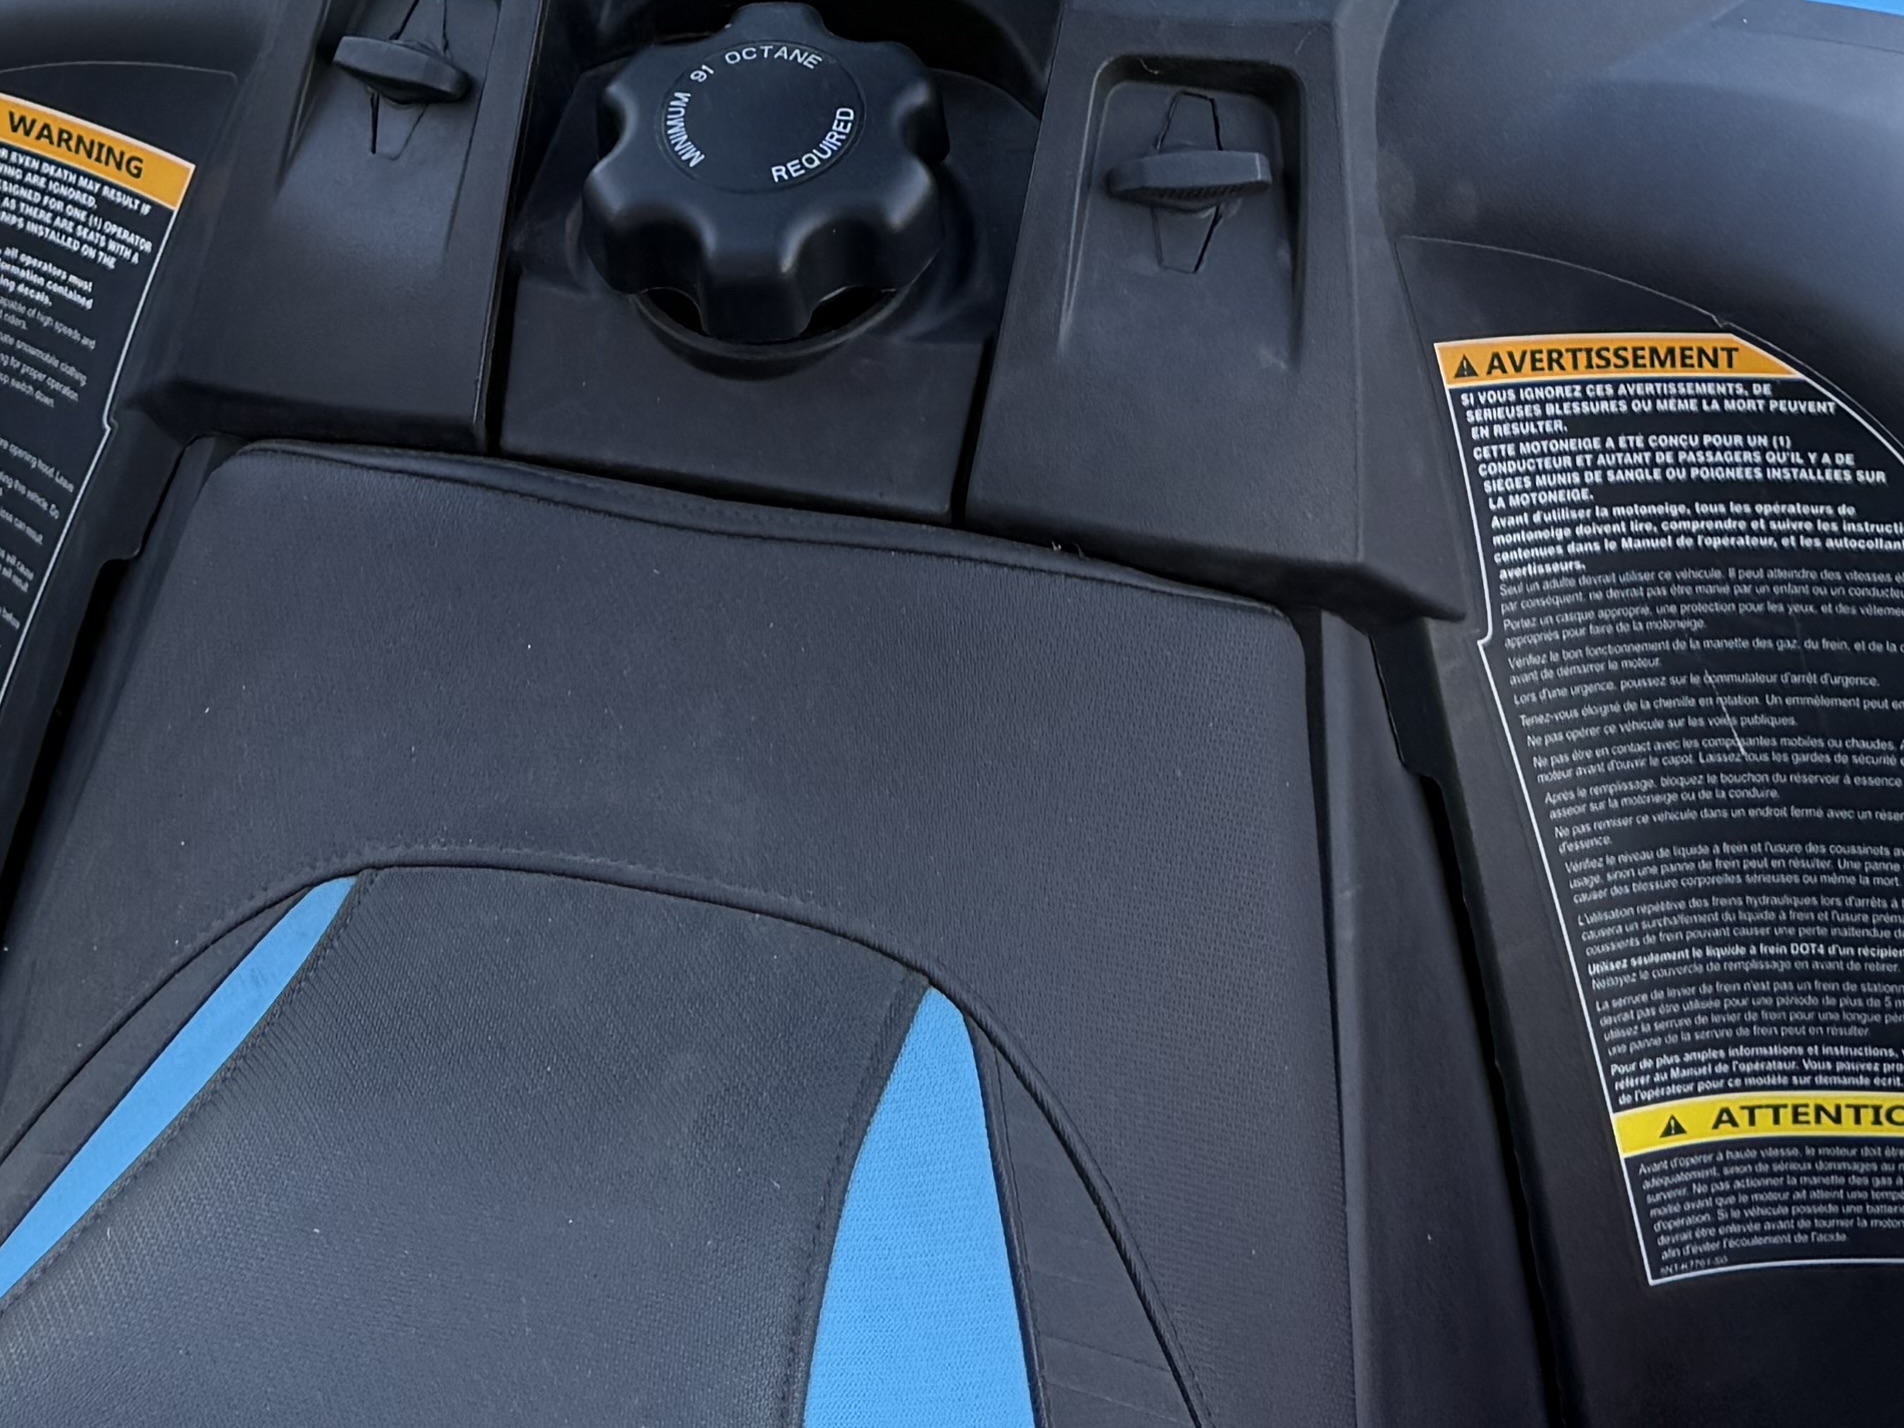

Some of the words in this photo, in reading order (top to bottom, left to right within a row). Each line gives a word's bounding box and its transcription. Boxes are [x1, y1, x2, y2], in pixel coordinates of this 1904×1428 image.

[725, 45, 823, 70] OCTANE
[689, 64, 715, 84] 91
[664, 90, 705, 169] MINIMUM
[8, 110, 144, 179] WARNING
[771, 107, 854, 183] REQUIRED
[10, 151, 40, 169] EVEN
[40, 162, 77, 181] DEATH
[78, 176, 101, 193] MAY
[102, 186, 140, 208] RESULT
[141, 203, 152, 215] IF
[24, 173, 46, 187] ARE
[49, 181, 97, 208] IGNORED.
[2, 197, 17, 210] AS
[19, 203, 53, 223] THERE
[53, 216, 74, 232] ARE
[76, 225, 106, 246] SEATS
[107, 240, 132, 260] WITH
[131, 252, 139, 264] A
[43, 197, 64, 212] FOR
[66, 206, 88, 221] ONE
[89, 215, 102, 229] (1)
[103, 221, 153, 252] OPERATOR
[26, 221, 80, 251] INSTALLED
[81, 244, 96, 259] ON
[97, 251, 117, 269] THE
[1486, 346, 1739, 375] AVERTISSEMENT
[1461, 393, 1474, 407] SI
[1478, 389, 1515, 405] VOUS
[1520, 386, 1581, 401] IGNOREZ
[1586, 384, 1613, 397] CES
[1753, 383, 1771, 396] DE
[1546, 399, 1627, 417] BLESSURES
[1632, 398, 1652, 412] OU
[1702, 399, 1719, 412] LA
[1724, 399, 1766, 413] MORT
[1770, 399, 1836, 415] PEUVENT
[1472, 426, 1489, 441] EN
[1474, 445, 1515, 461] CETTE
[1520, 438, 1601, 455] MOTONEIGE
[1605, 437, 1615, 449] A
[1704, 435, 1742, 448] POUR
[1747, 435, 1768, 448] UN
[1772, 436, 1791, 449] (1)
[1479, 456, 1572, 477] CONDUCTEUR
[1576, 454, 1592, 467] ET
[1597, 452, 1651, 467] AUTANT
[1656, 451, 1673, 464] DE
[1678, 451, 1761, 465] PASSAGERS
[1766, 452, 1804, 465] QU'IL
[1808, 453, 1817, 464] Y
[1821, 453, 1831, 465] A
[1835, 453, 1854, 466] DE
[1536, 471, 1580, 489] MUNIS
[1585, 470, 1602, 484] DE
[1607, 468, 1661, 484] SANGLE
[1666, 468, 1686, 481] OU
[1857, 470, 1887, 484] SUR
[1489, 496, 1505, 511] LA
[1509, 488, 1594, 508] MOTONEIGE.
[1492, 512, 1529, 529] Avant
[1533, 507, 1591, 524] d'utiliser
[1596, 505, 1608, 517] la
[1613, 502, 1691, 517] motoneige,
[1695, 502, 1725, 515] tous
[1730, 502, 1750, 514] les
[1755, 502, 1833, 516] opérateurs
[1838, 504, 1856, 516] de
[1575, 520, 1626, 535] doivent
[1631, 519, 1657, 533] lire,
[1661, 518, 1746, 533] comprendre
[1751, 519, 1765, 532] et
[1770, 521, 1812, 533] suivre
[1817, 520, 1838, 533] les
[1494, 545, 1563, 564] contenues
[1568, 541, 1600, 556] dans
[1605, 539, 1617, 552] le
[1621, 536, 1672, 551] Manuel
[1676, 535, 1693, 549] de
[1781, 535, 1796, 548] et
[1800, 535, 1821, 549] les
[1499, 560, 1586, 580] avertisseurs.
